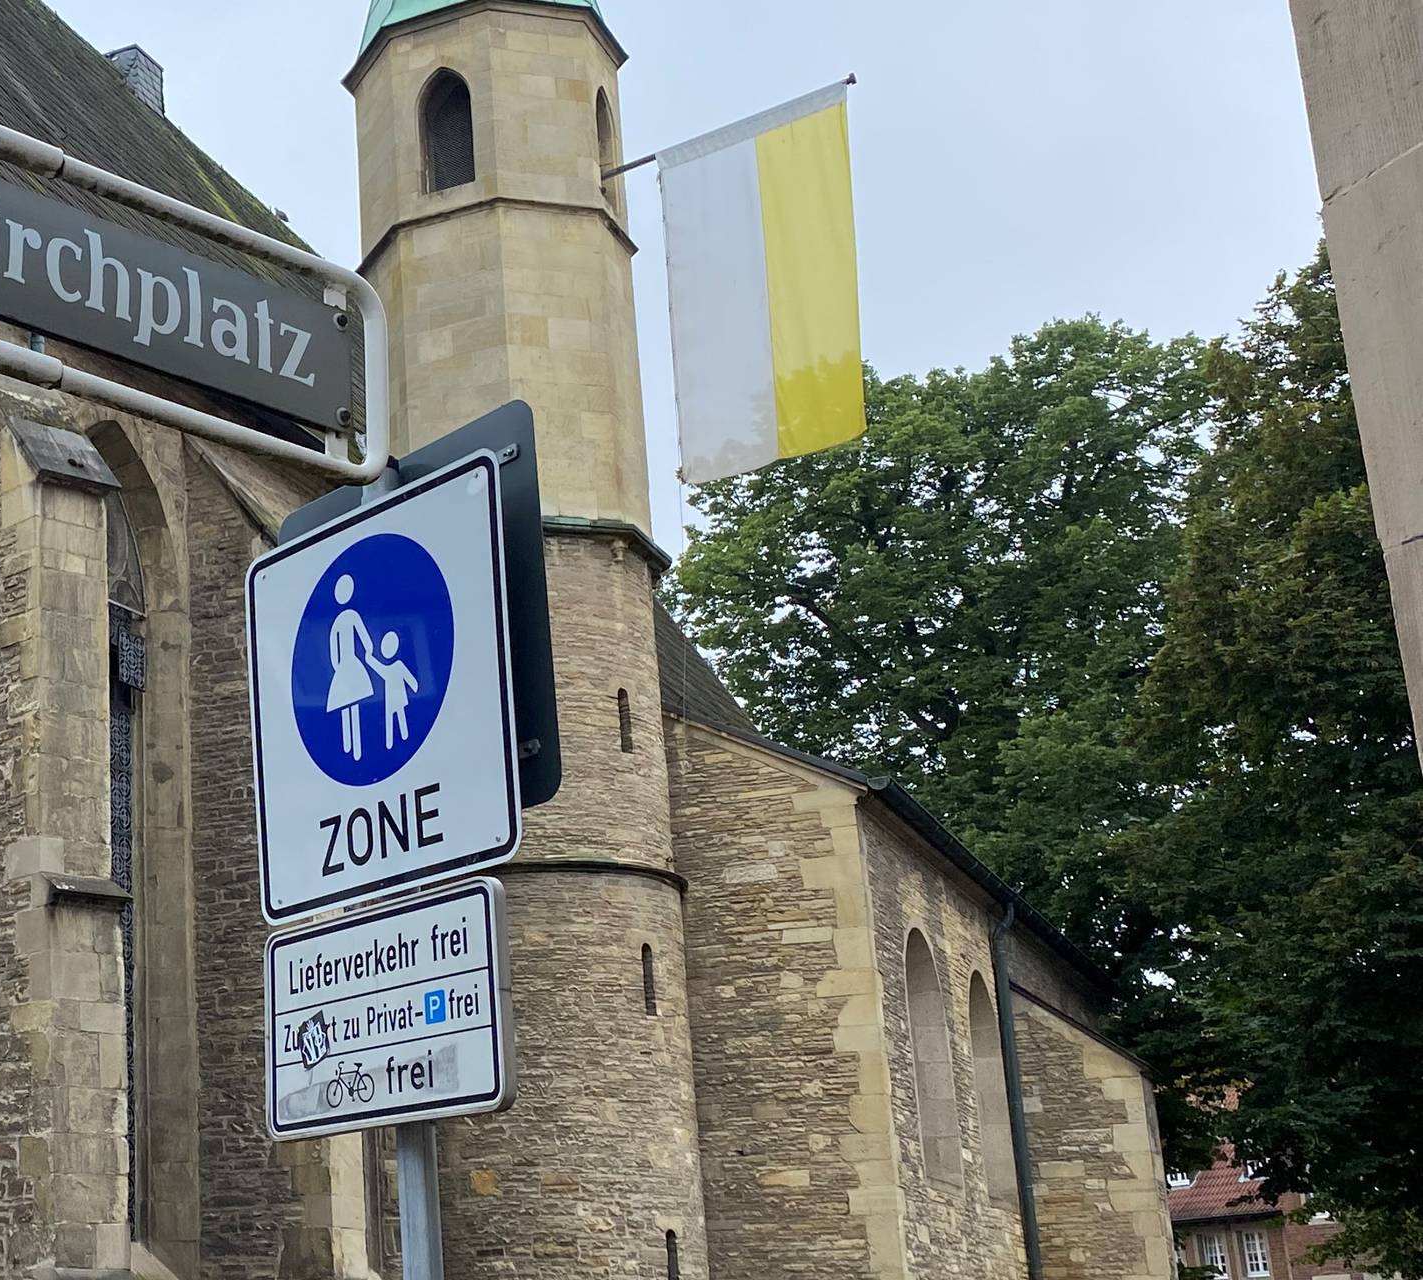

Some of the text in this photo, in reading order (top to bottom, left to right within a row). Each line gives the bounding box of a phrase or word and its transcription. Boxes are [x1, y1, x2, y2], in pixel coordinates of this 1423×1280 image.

[319, 783, 444, 877] ZONE
[289, 917, 468, 995] Lieferverkehr frei
[284, 1016, 337, 1053] Zurt
[343, 1016, 360, 1041] zu
[448, 984, 479, 1020] frei
[386, 1050, 434, 1094] frei
